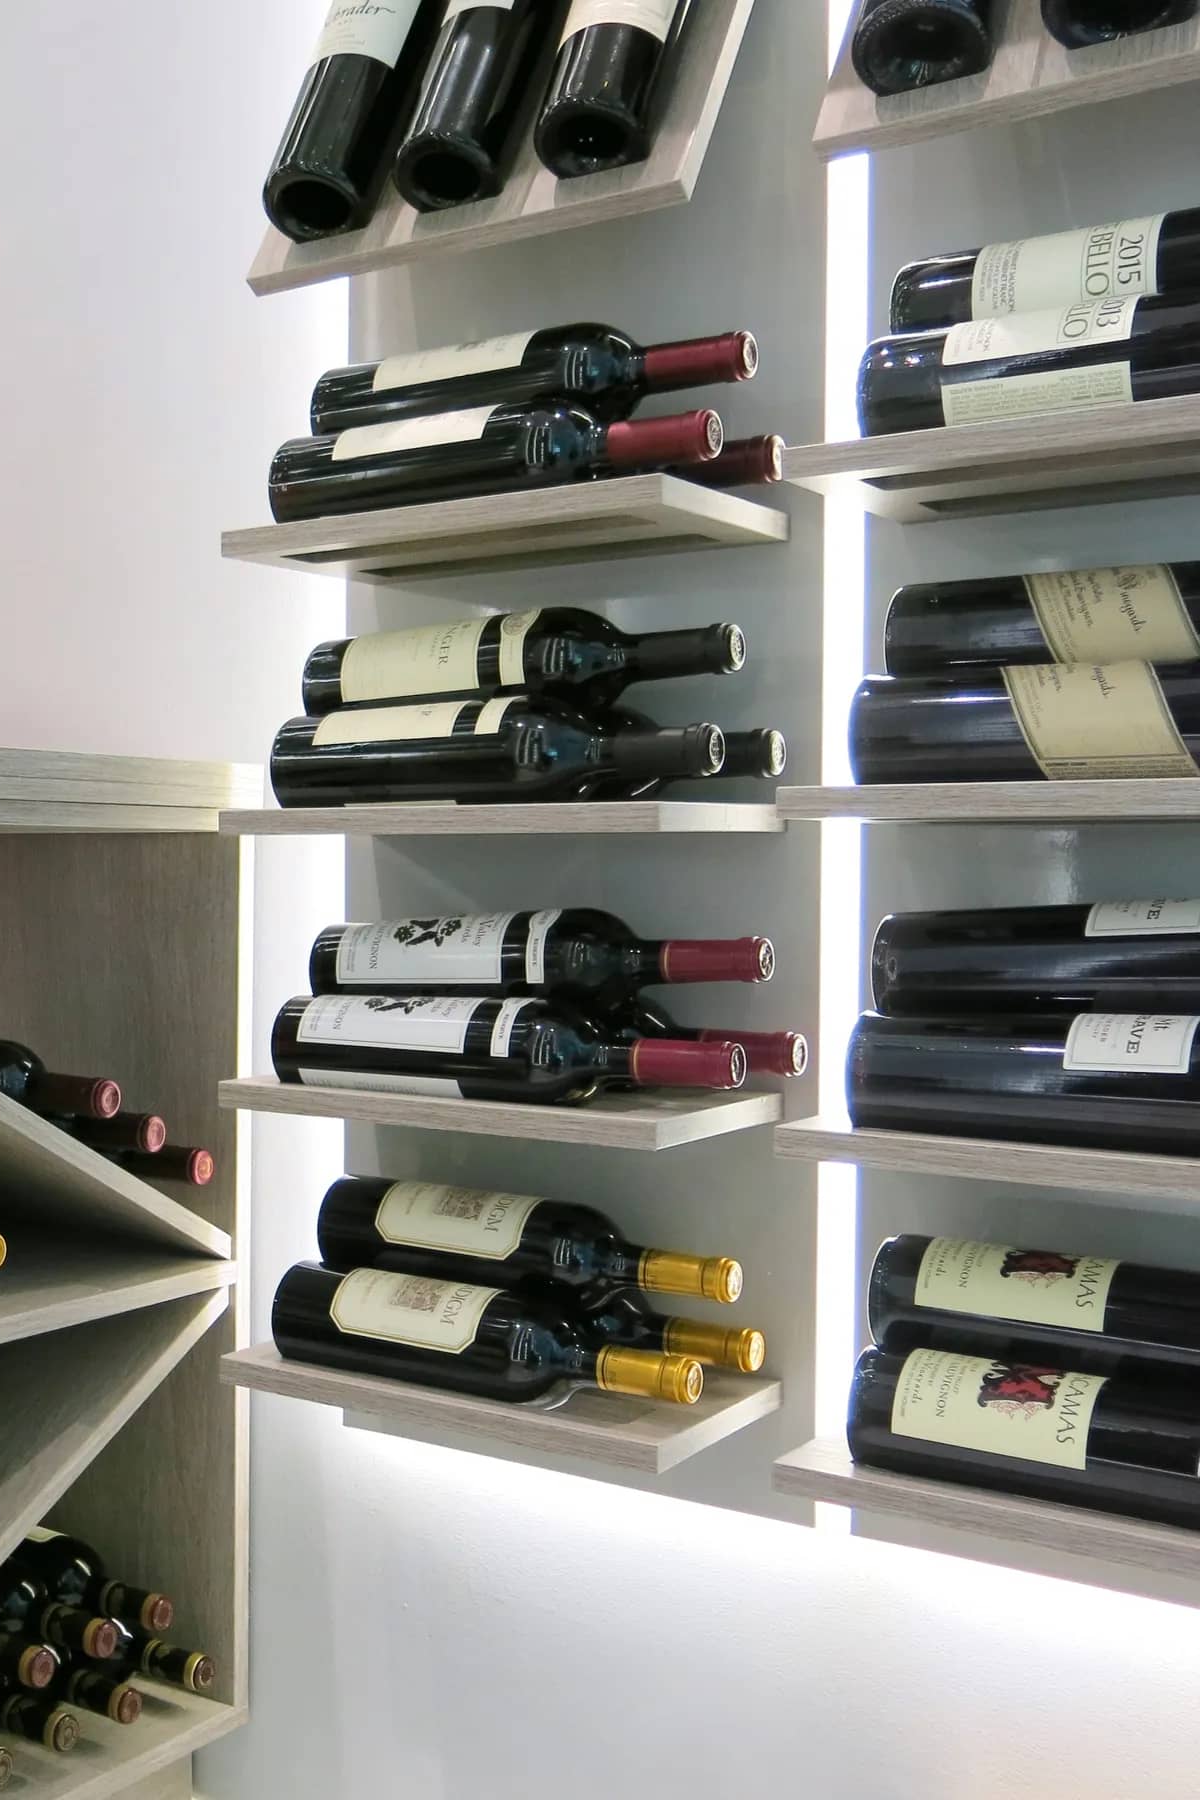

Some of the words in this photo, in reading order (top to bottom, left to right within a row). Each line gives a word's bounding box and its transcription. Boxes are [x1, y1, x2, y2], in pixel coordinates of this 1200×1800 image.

[1085, 231, 1114, 297] BELLO
[1117, 233, 1144, 285] 2015
[1096, 299, 1125, 328] 013
